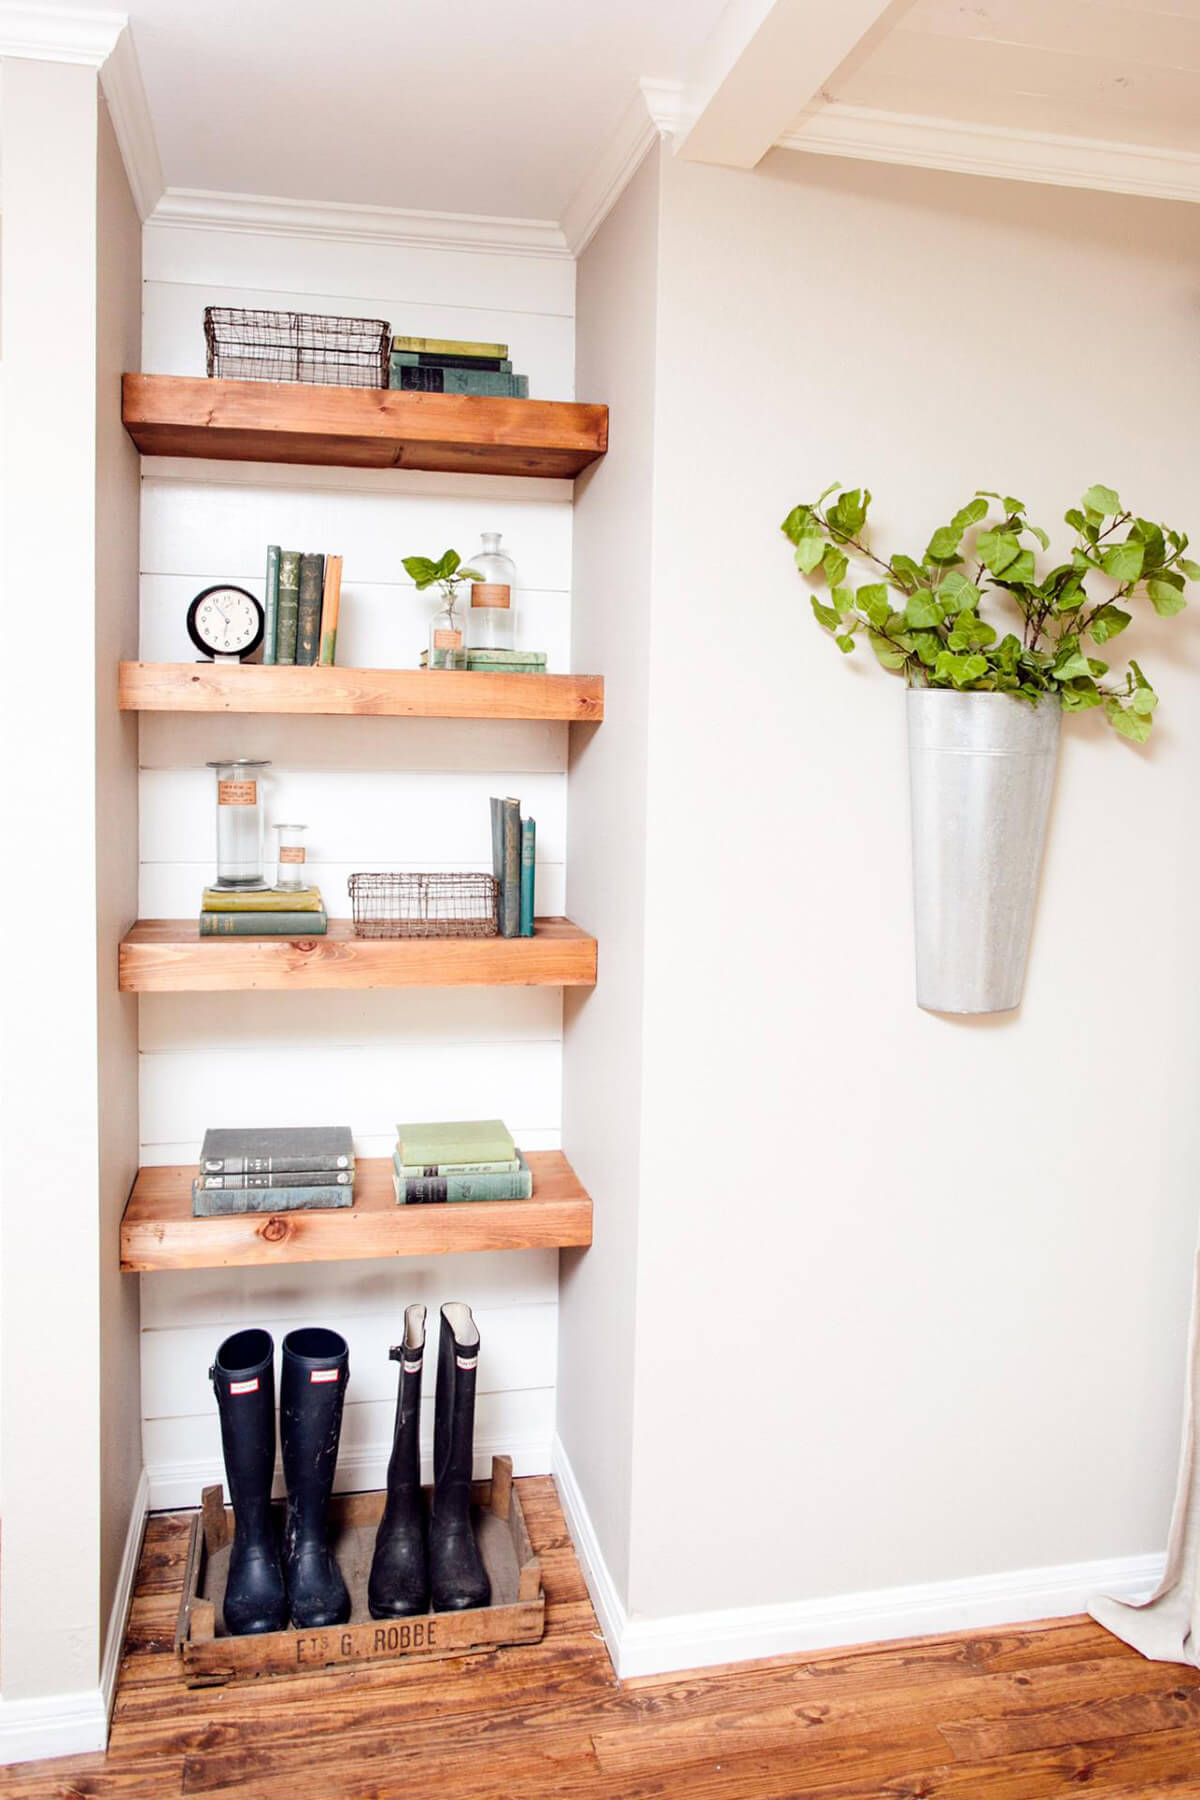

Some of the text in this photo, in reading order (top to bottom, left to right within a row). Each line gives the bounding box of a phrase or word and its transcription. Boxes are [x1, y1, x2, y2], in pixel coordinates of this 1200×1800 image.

[205, 1177, 223, 1188] R
[340, 1633, 361, 1656] G.
[374, 1621, 437, 1652] ROBBE
